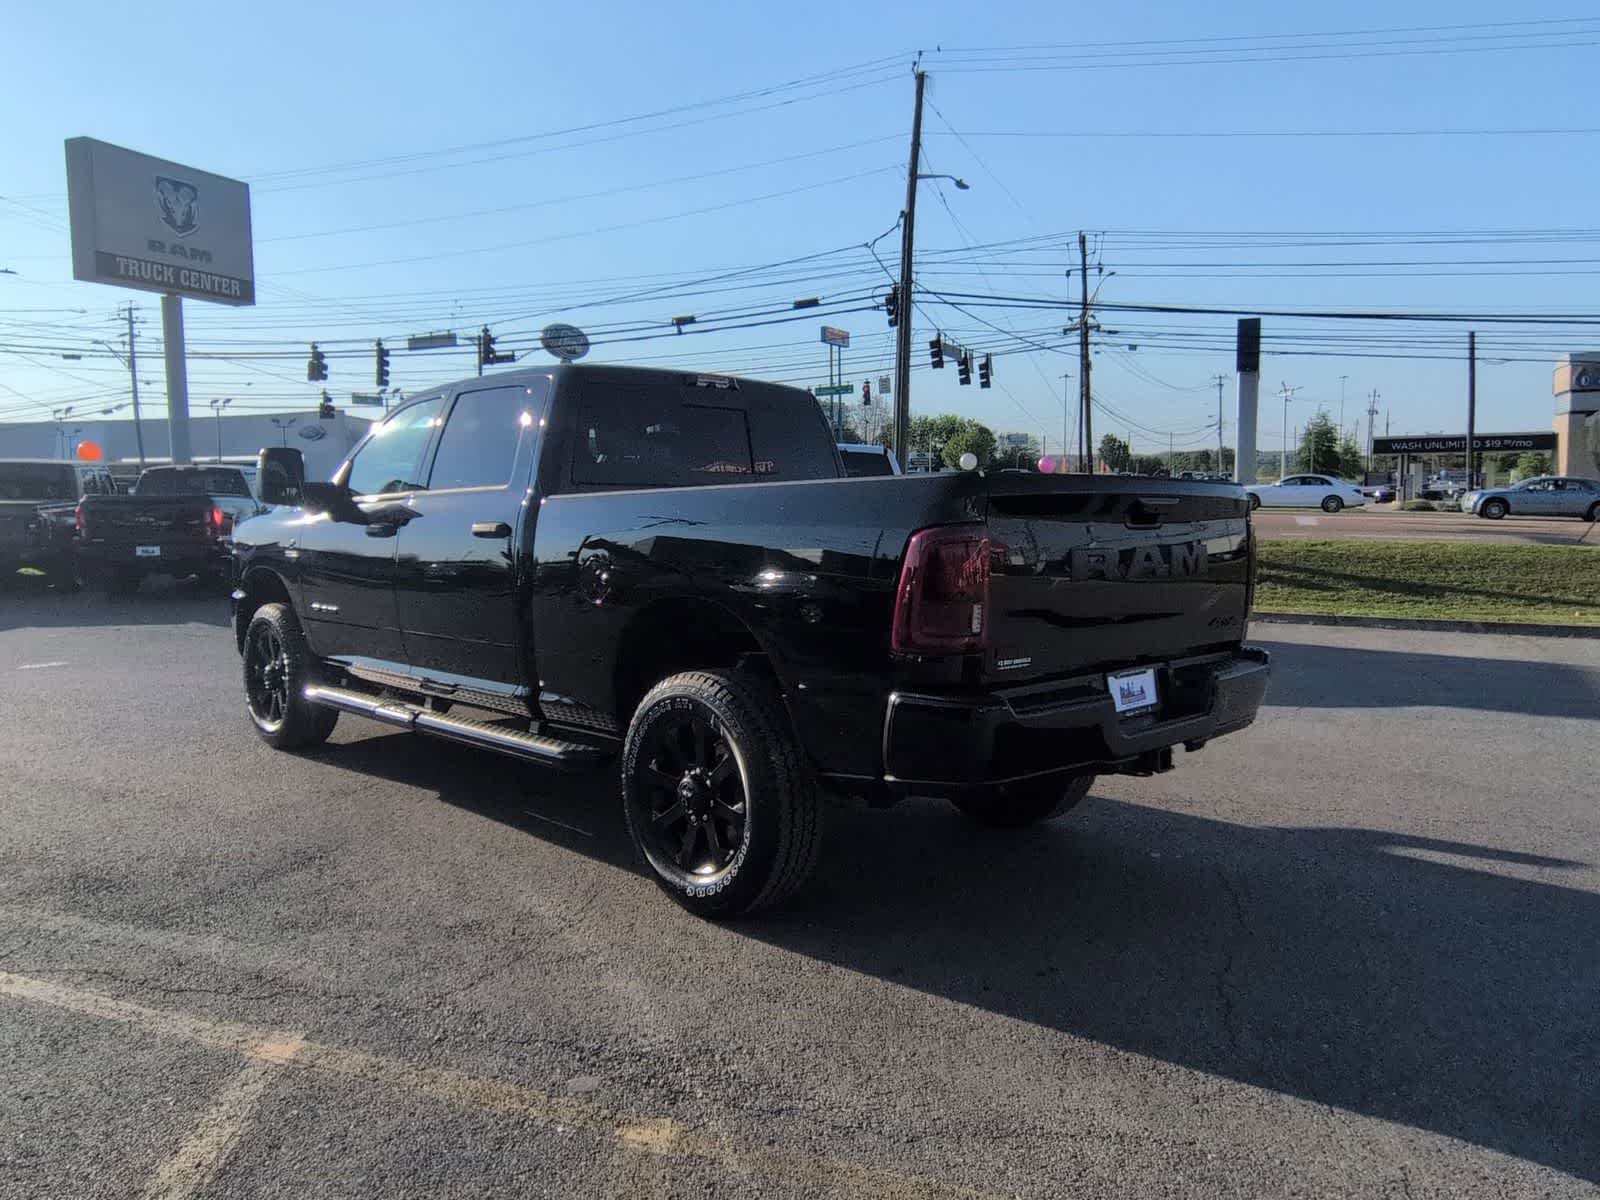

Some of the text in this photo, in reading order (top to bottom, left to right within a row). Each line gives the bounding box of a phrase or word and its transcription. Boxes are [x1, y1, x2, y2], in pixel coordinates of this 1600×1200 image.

[147, 239, 213, 264] RAM
[116, 257, 241, 296] TRUCK CENTER
[1391, 441, 1422, 451] WASH
[1424, 439, 1481, 450] UNLIMITD
[1071, 542, 1208, 579] RAM
